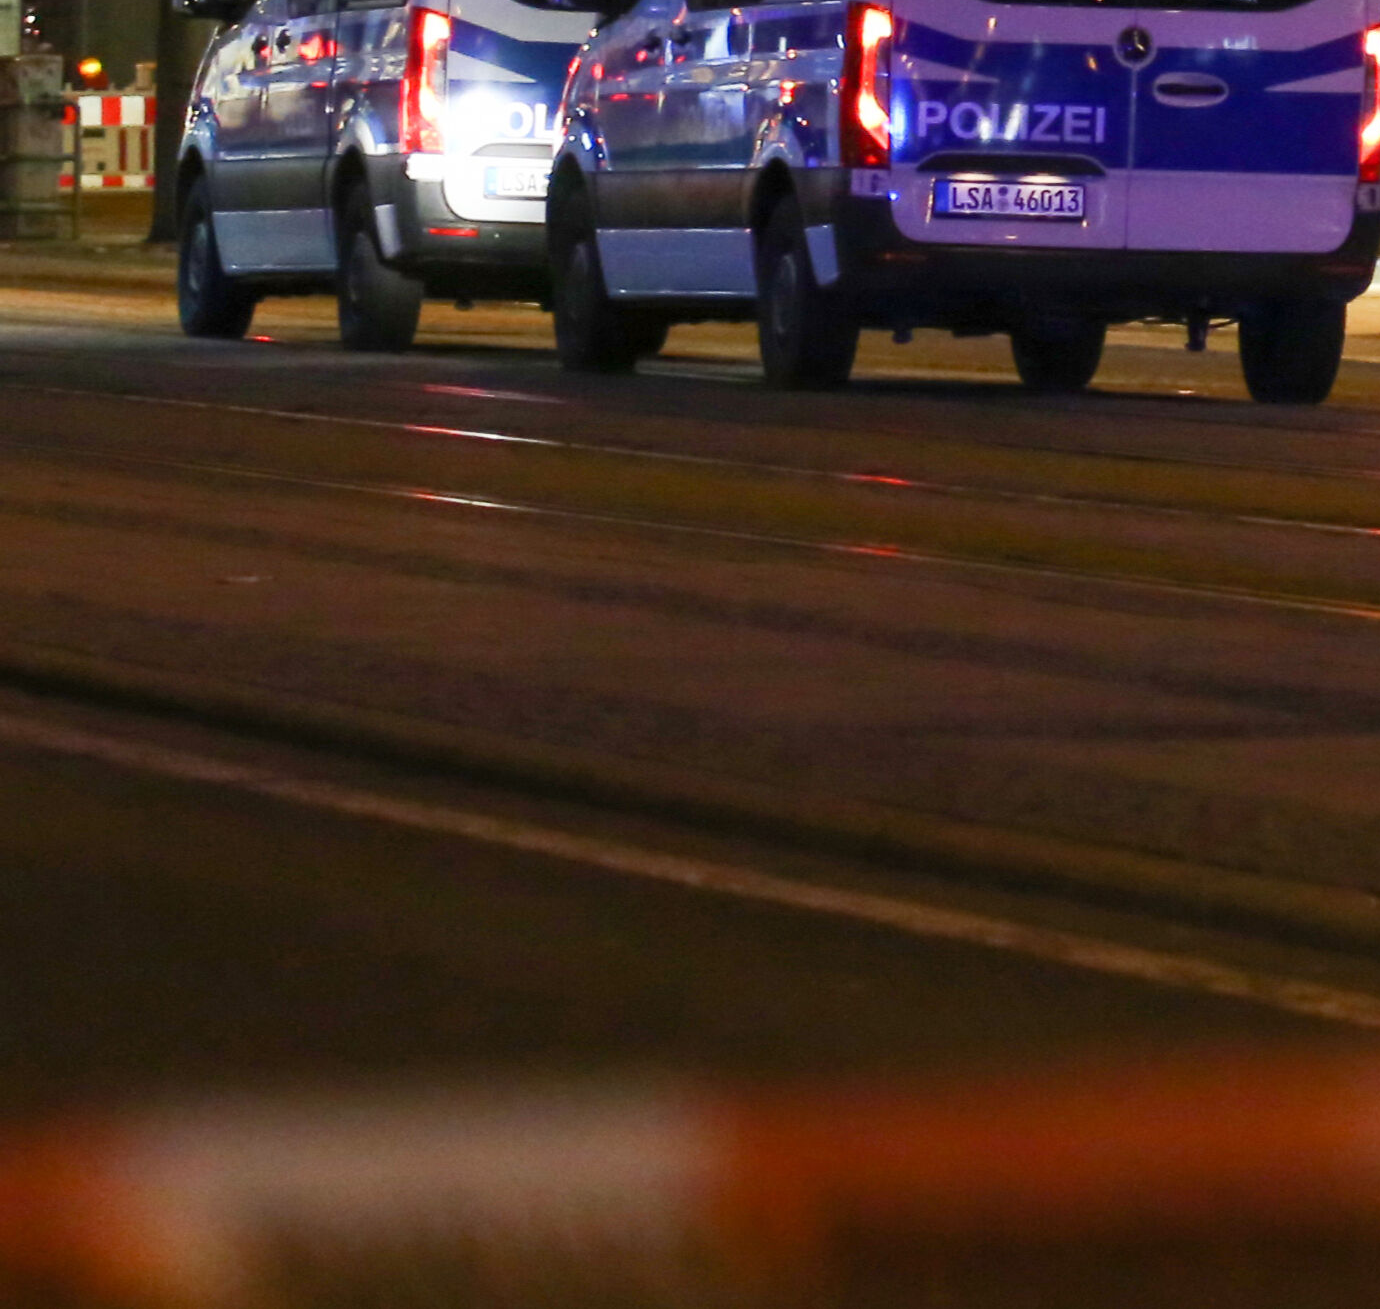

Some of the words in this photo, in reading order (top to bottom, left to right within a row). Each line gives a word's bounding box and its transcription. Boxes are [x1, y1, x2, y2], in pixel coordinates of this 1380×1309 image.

[916, 100, 1107, 144] POLIZEI
[951, 187, 994, 211] LSA
[1013, 190, 1081, 213] 46013
